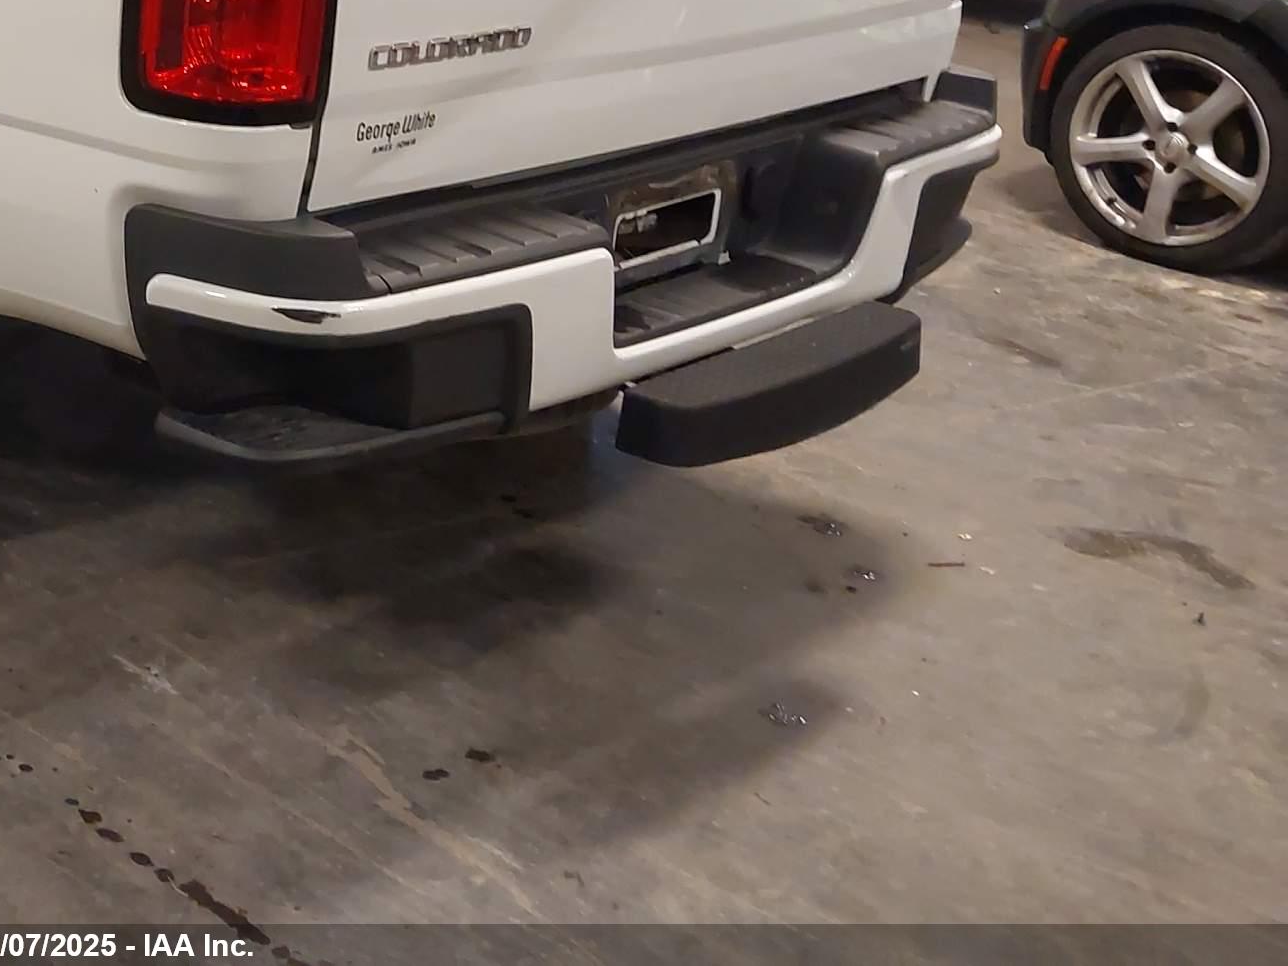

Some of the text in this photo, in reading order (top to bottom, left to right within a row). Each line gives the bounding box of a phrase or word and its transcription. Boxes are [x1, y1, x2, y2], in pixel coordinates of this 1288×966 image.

[368, 27, 532, 71] COLORADO
[356, 110, 436, 143] George White
